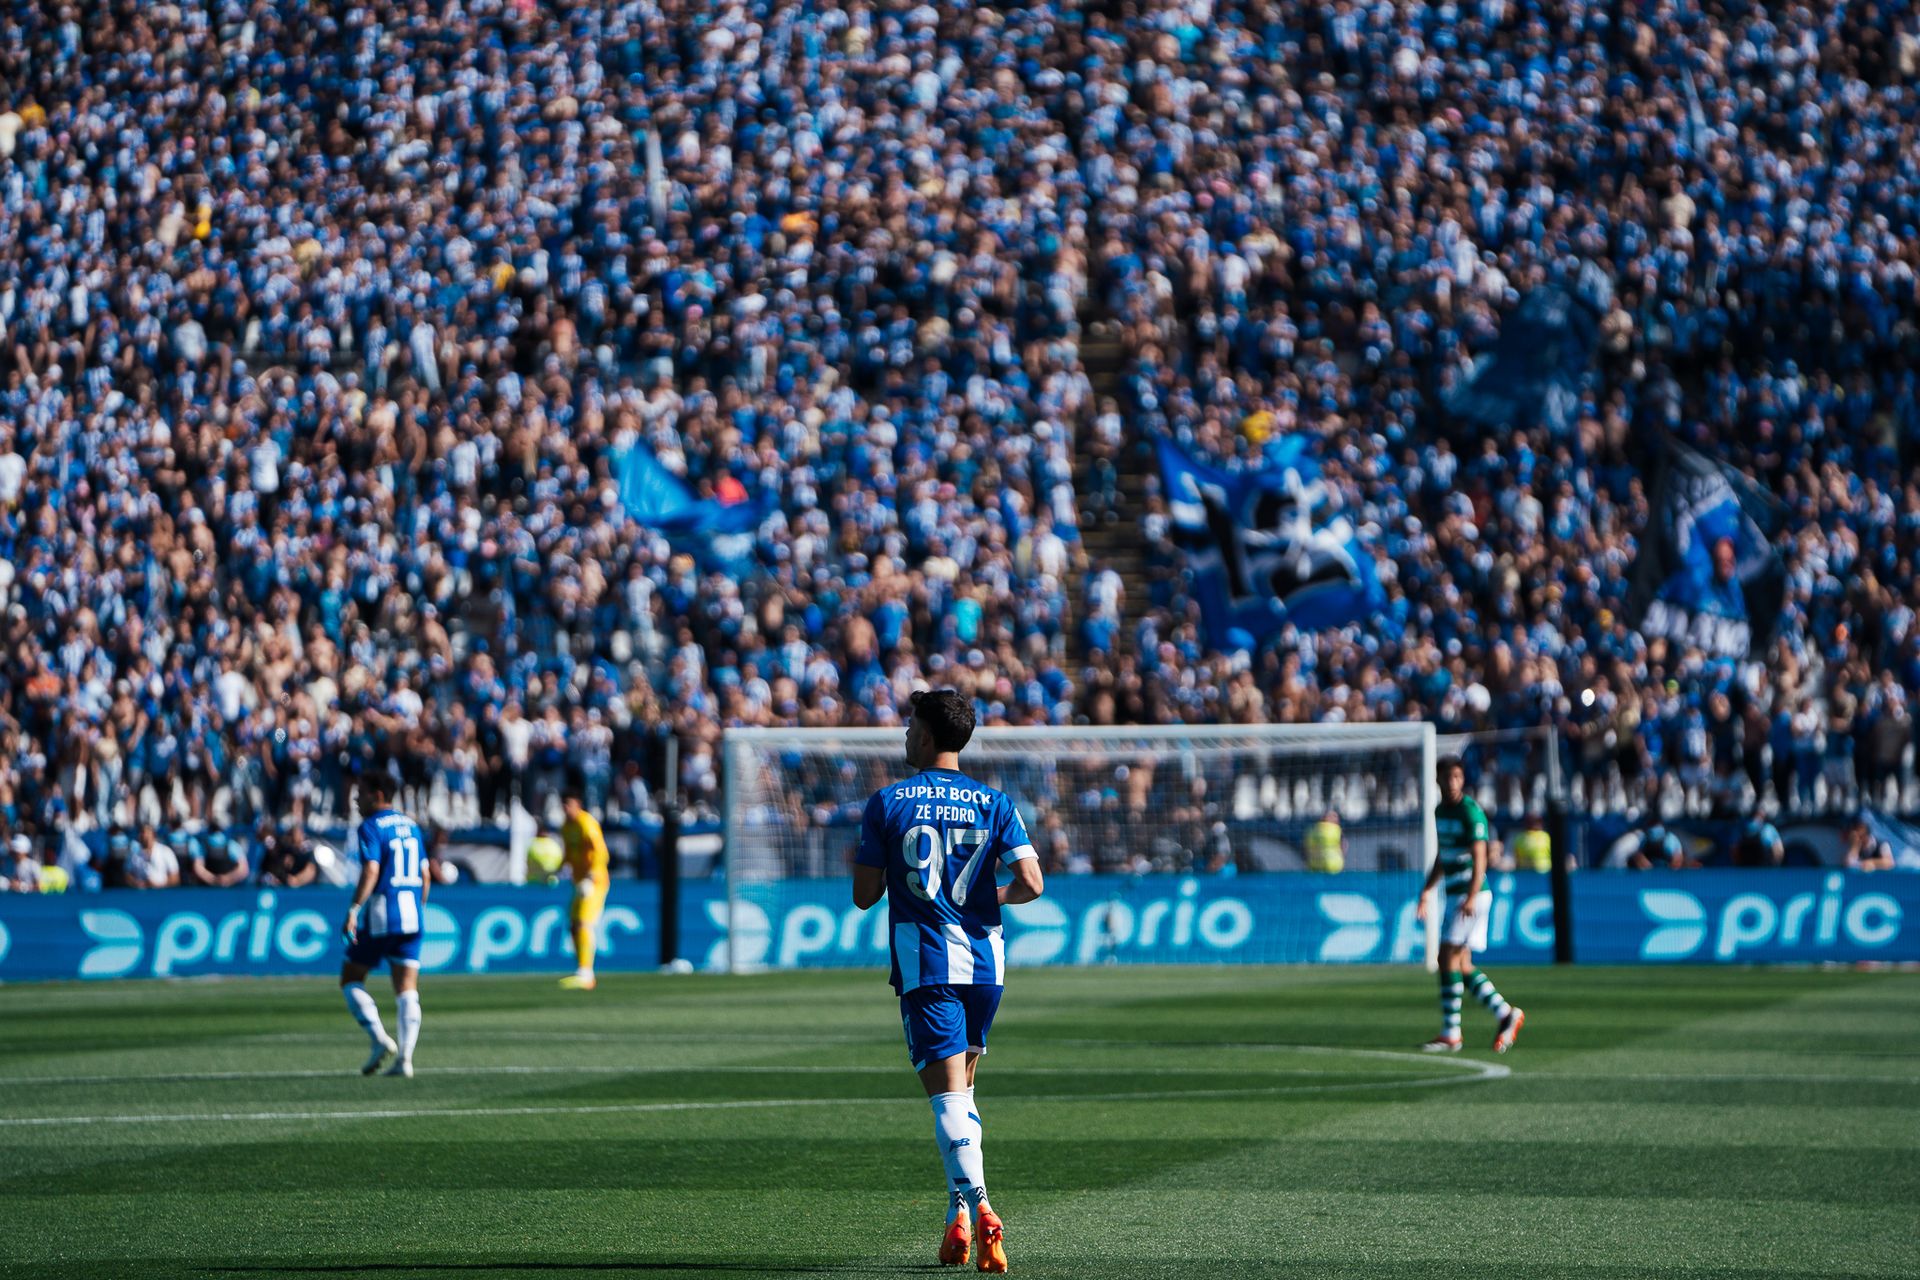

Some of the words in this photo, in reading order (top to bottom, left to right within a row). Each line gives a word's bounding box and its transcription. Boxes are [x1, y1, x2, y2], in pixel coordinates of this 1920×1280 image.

[895, 785, 946, 800] SUPER
[949, 787, 992, 805] BOCK
[916, 804, 931, 820] ZÉ
[936, 807, 975, 823] PEDRO
[388, 837, 423, 887] 11
[902, 824, 990, 906] 97
[1077, 876, 1252, 963] prio
